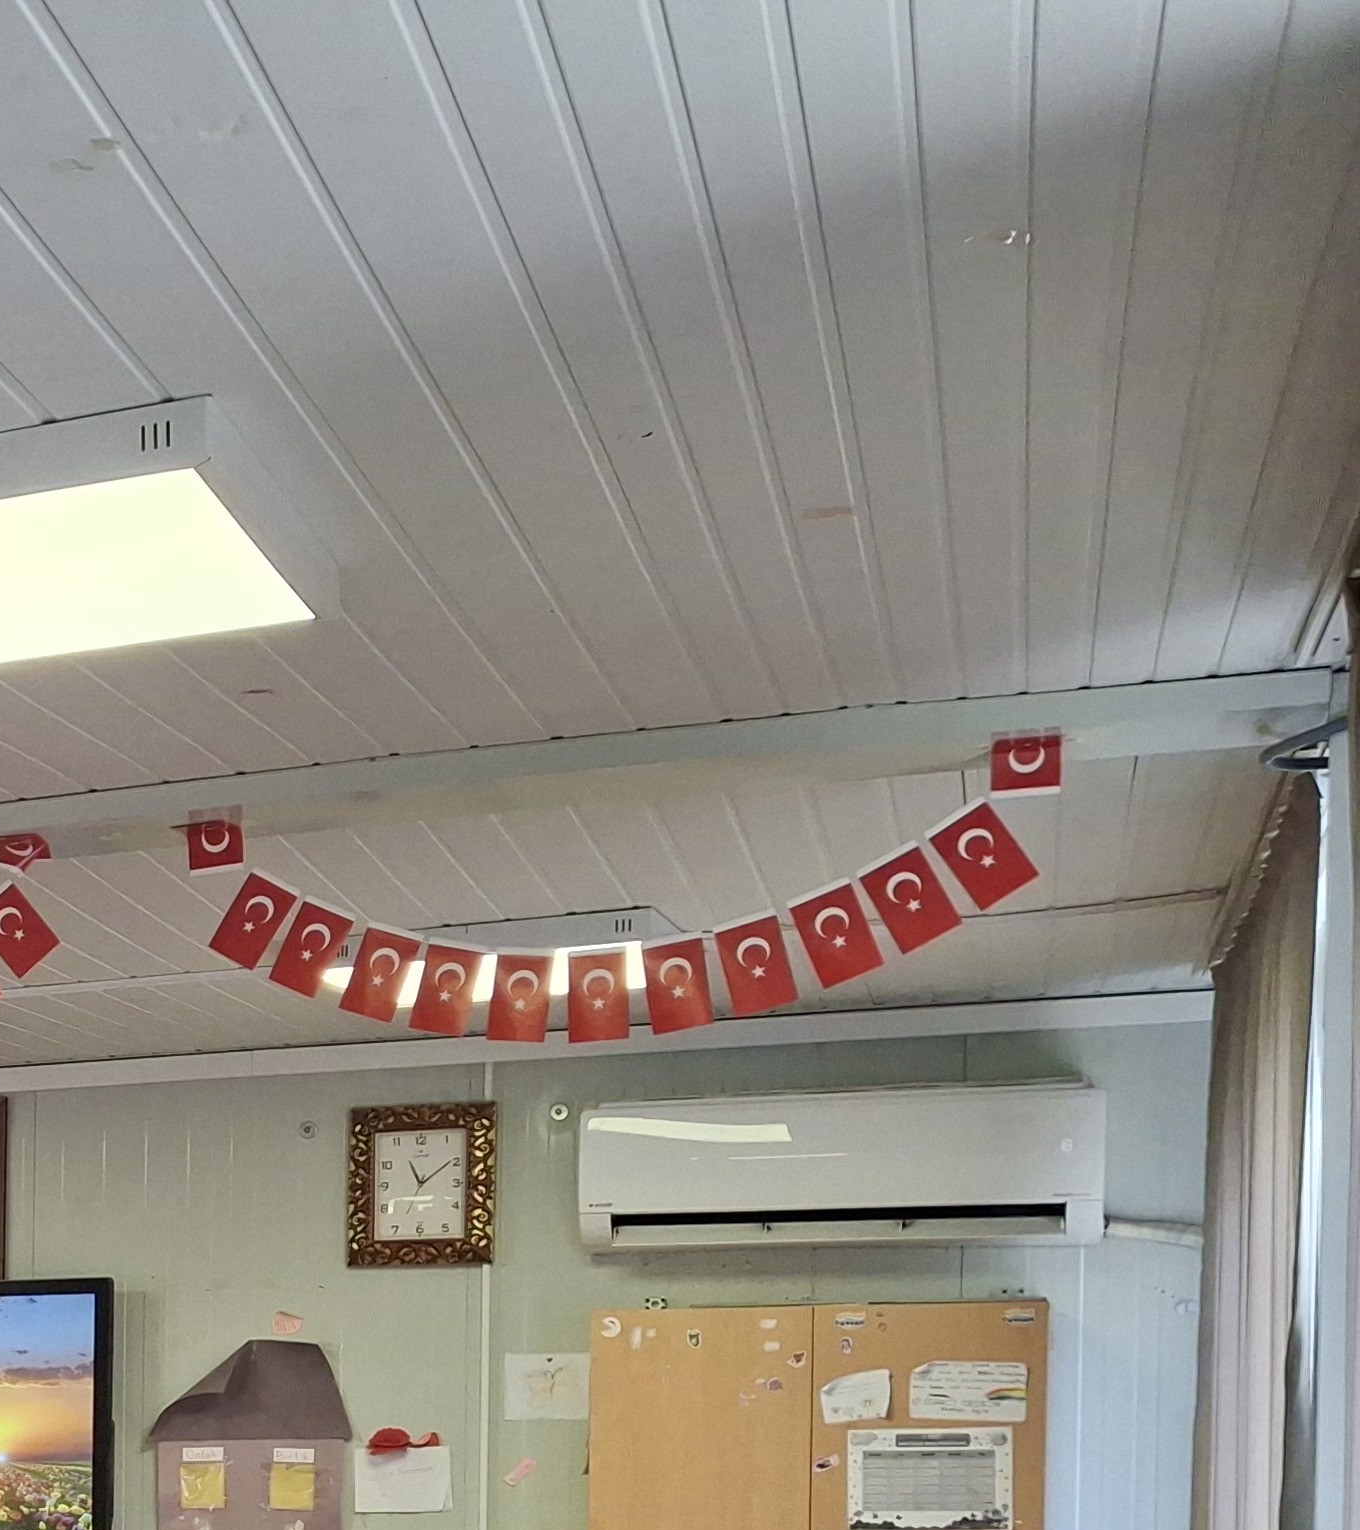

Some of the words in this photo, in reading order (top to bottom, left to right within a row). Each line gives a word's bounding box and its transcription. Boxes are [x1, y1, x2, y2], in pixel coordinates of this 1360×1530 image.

[392, 1137, 401, 1146] 11
[415, 1136, 427, 1146] 12
[381, 1160, 393, 1170] 10
[452, 1157, 461, 1166] 2
[381, 1181, 389, 1191] 9
[452, 1179, 461, 1188] 3
[451, 1201, 460, 1210] 4
[391, 1225, 399, 1234] 7
[415, 1224, 424, 1234] 6
[441, 1223, 450, 1233] 5
